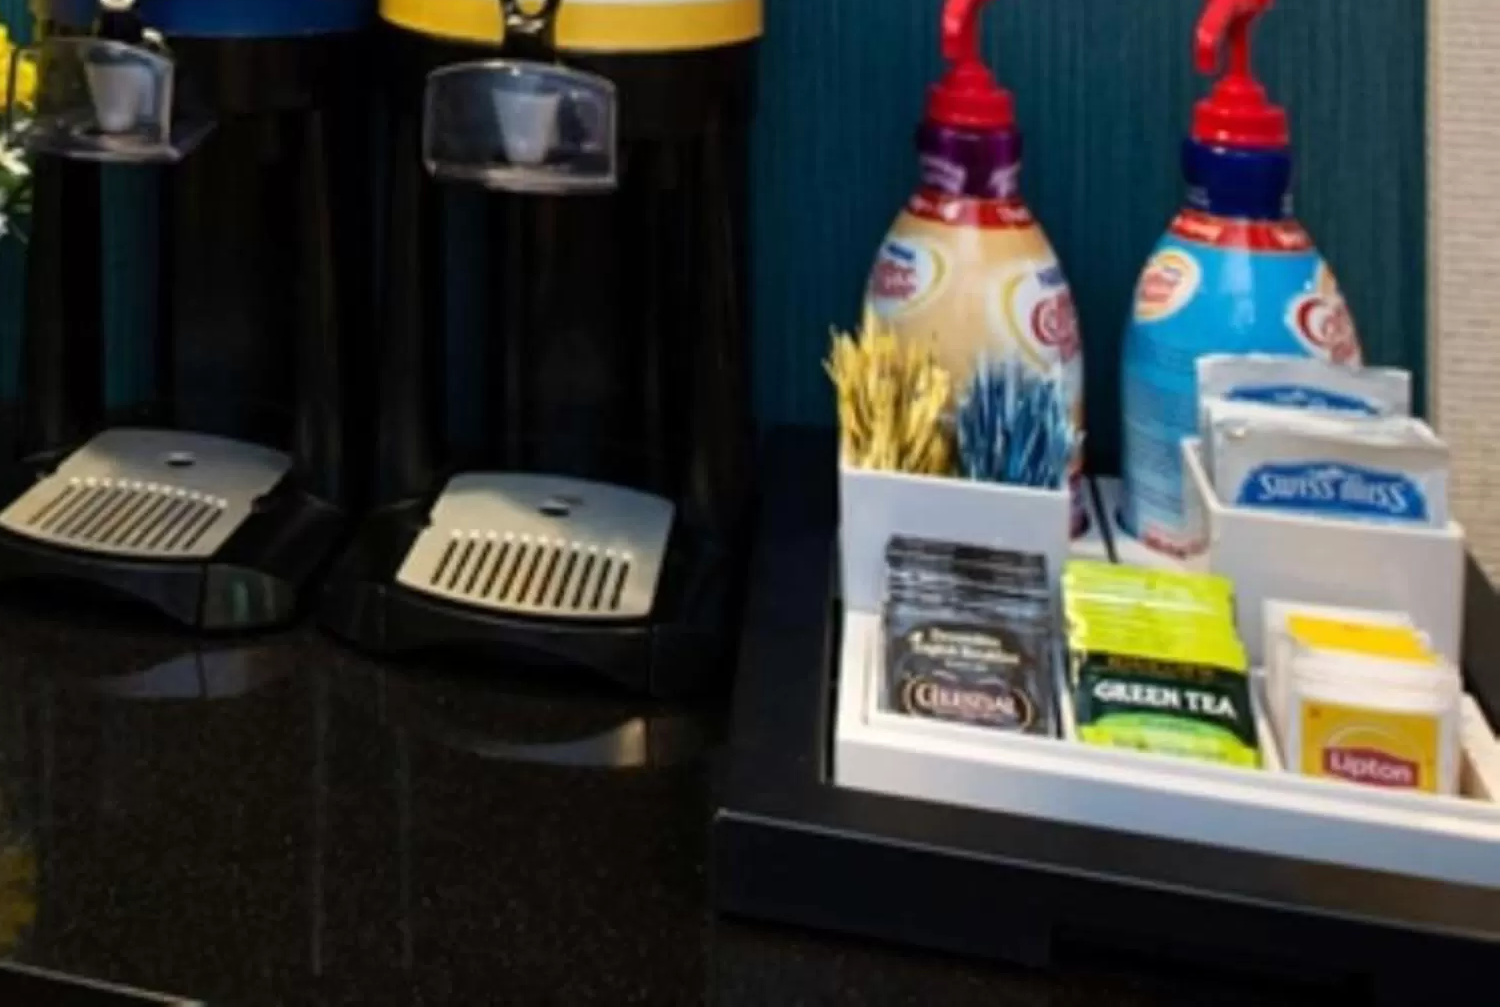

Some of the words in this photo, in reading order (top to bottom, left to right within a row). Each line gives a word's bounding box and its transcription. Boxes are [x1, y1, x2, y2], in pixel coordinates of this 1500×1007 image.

[1094, 679, 1181, 708] GREEN
[1185, 690, 1238, 720] TEA
[1330, 749, 1414, 785] Lipton
